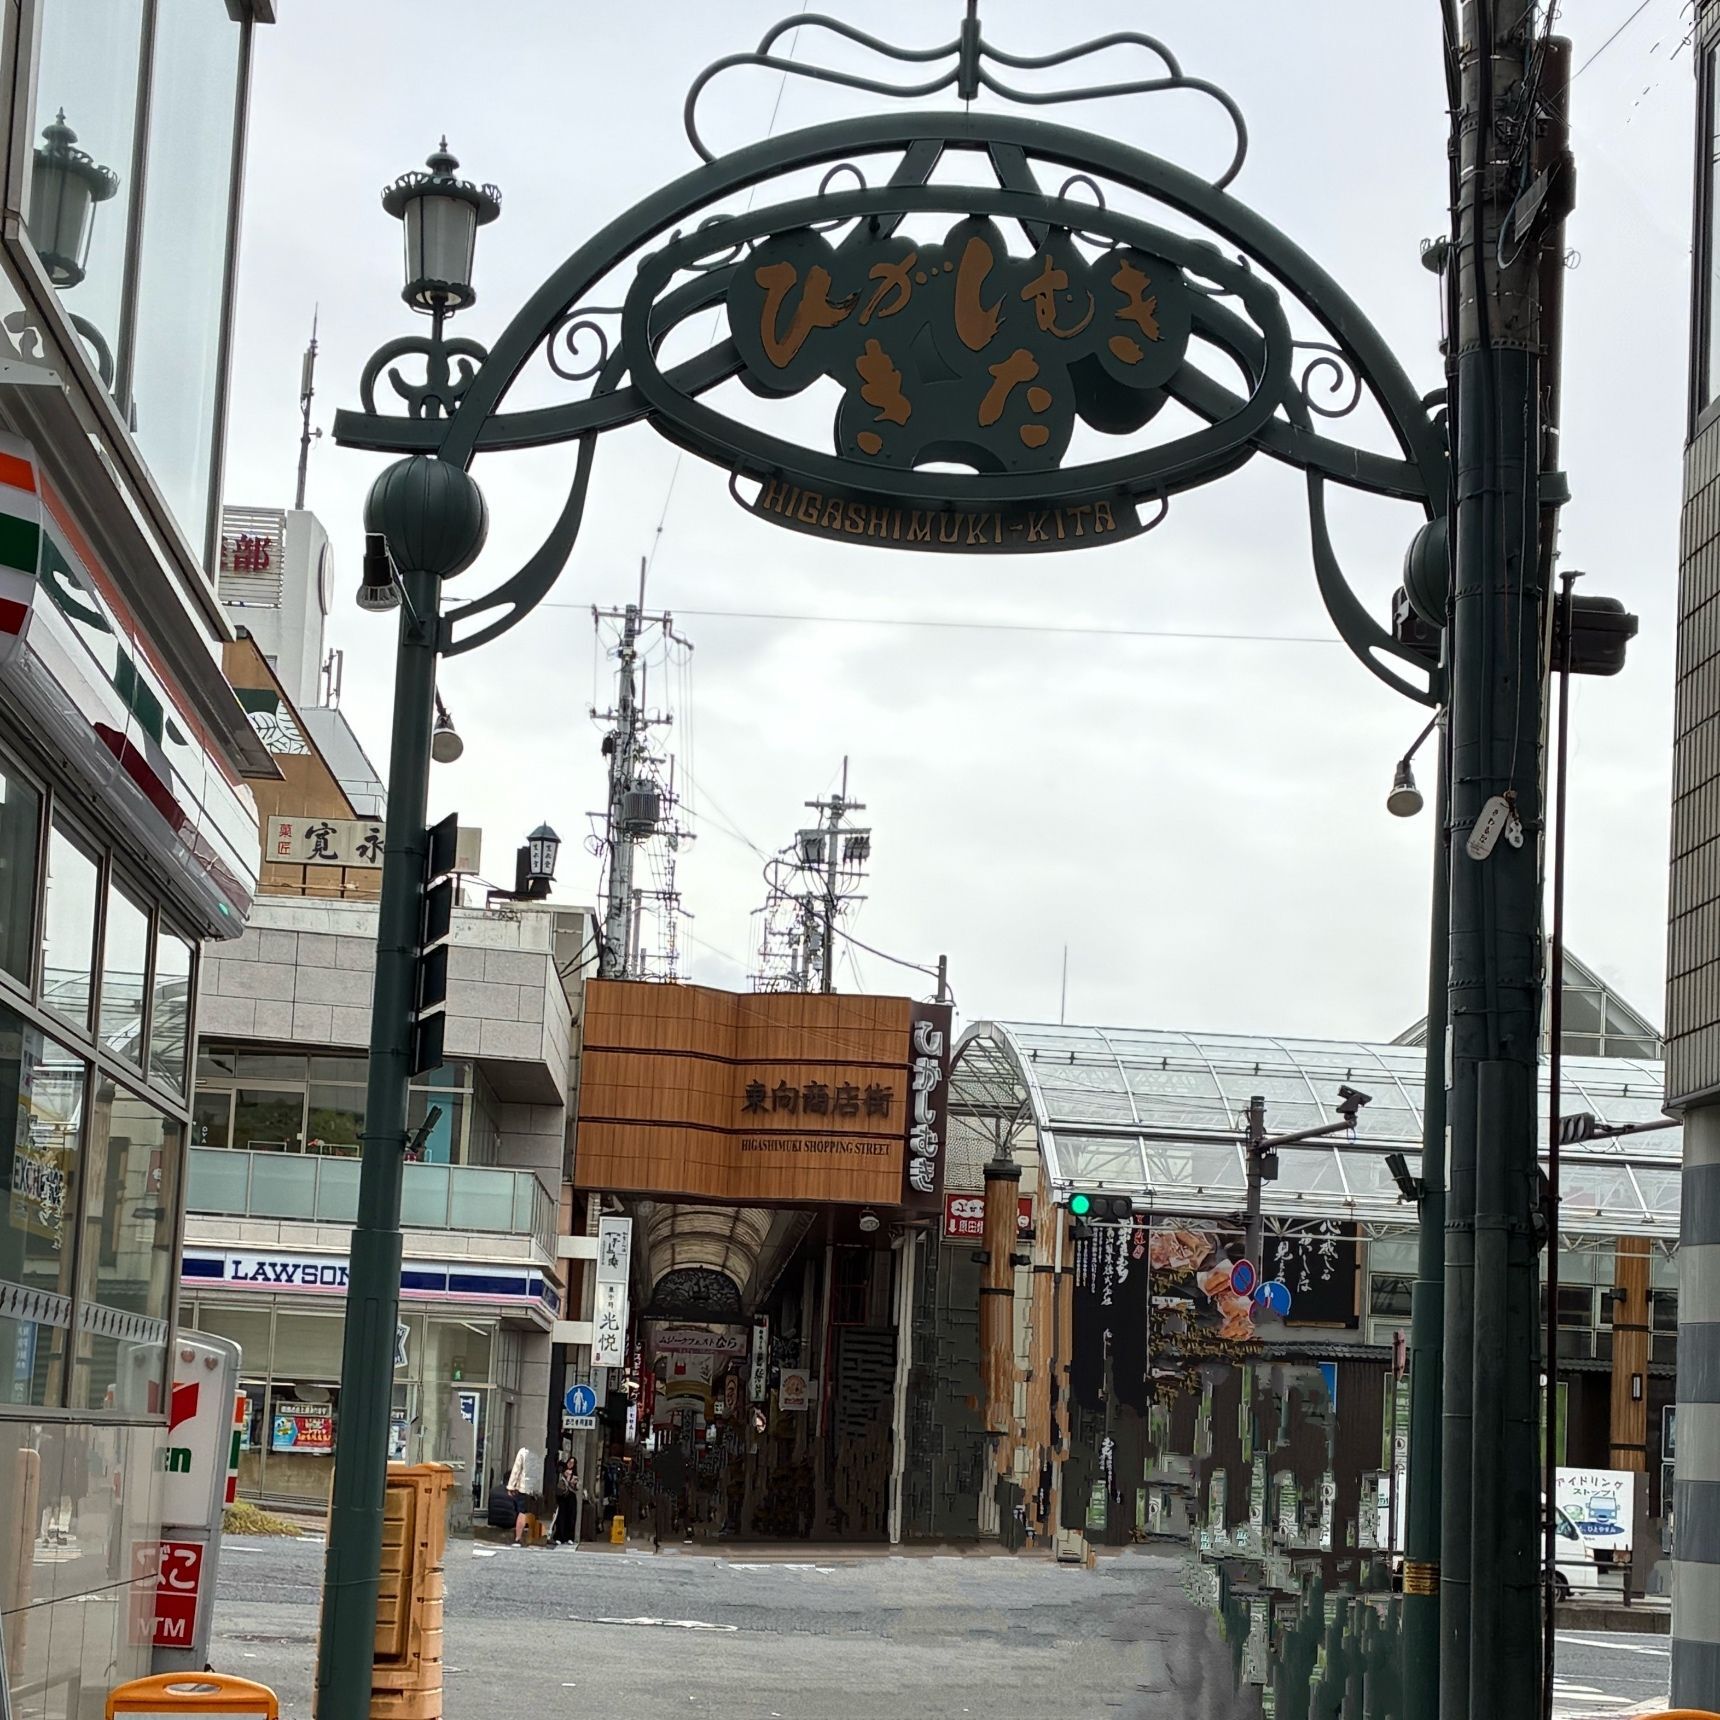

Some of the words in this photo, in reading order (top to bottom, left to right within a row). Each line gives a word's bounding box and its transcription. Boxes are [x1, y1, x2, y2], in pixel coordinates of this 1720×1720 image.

[755, 236, 1165, 368] ひがしむき
[855, 338, 1053, 456] きた
[762, 479, 1116, 545] HIGASHIMUKI-KITA
[740, 1078, 895, 1118] 東向商店街
[910, 1020, 943, 1193] ひがしむき
[741, 1139, 802, 1152] HIGASHIMUKI
[805, 1140, 853, 1154] SHOPPING
[855, 1143, 892, 1156] STREET
[598, 1311, 620, 1352] 光悦
